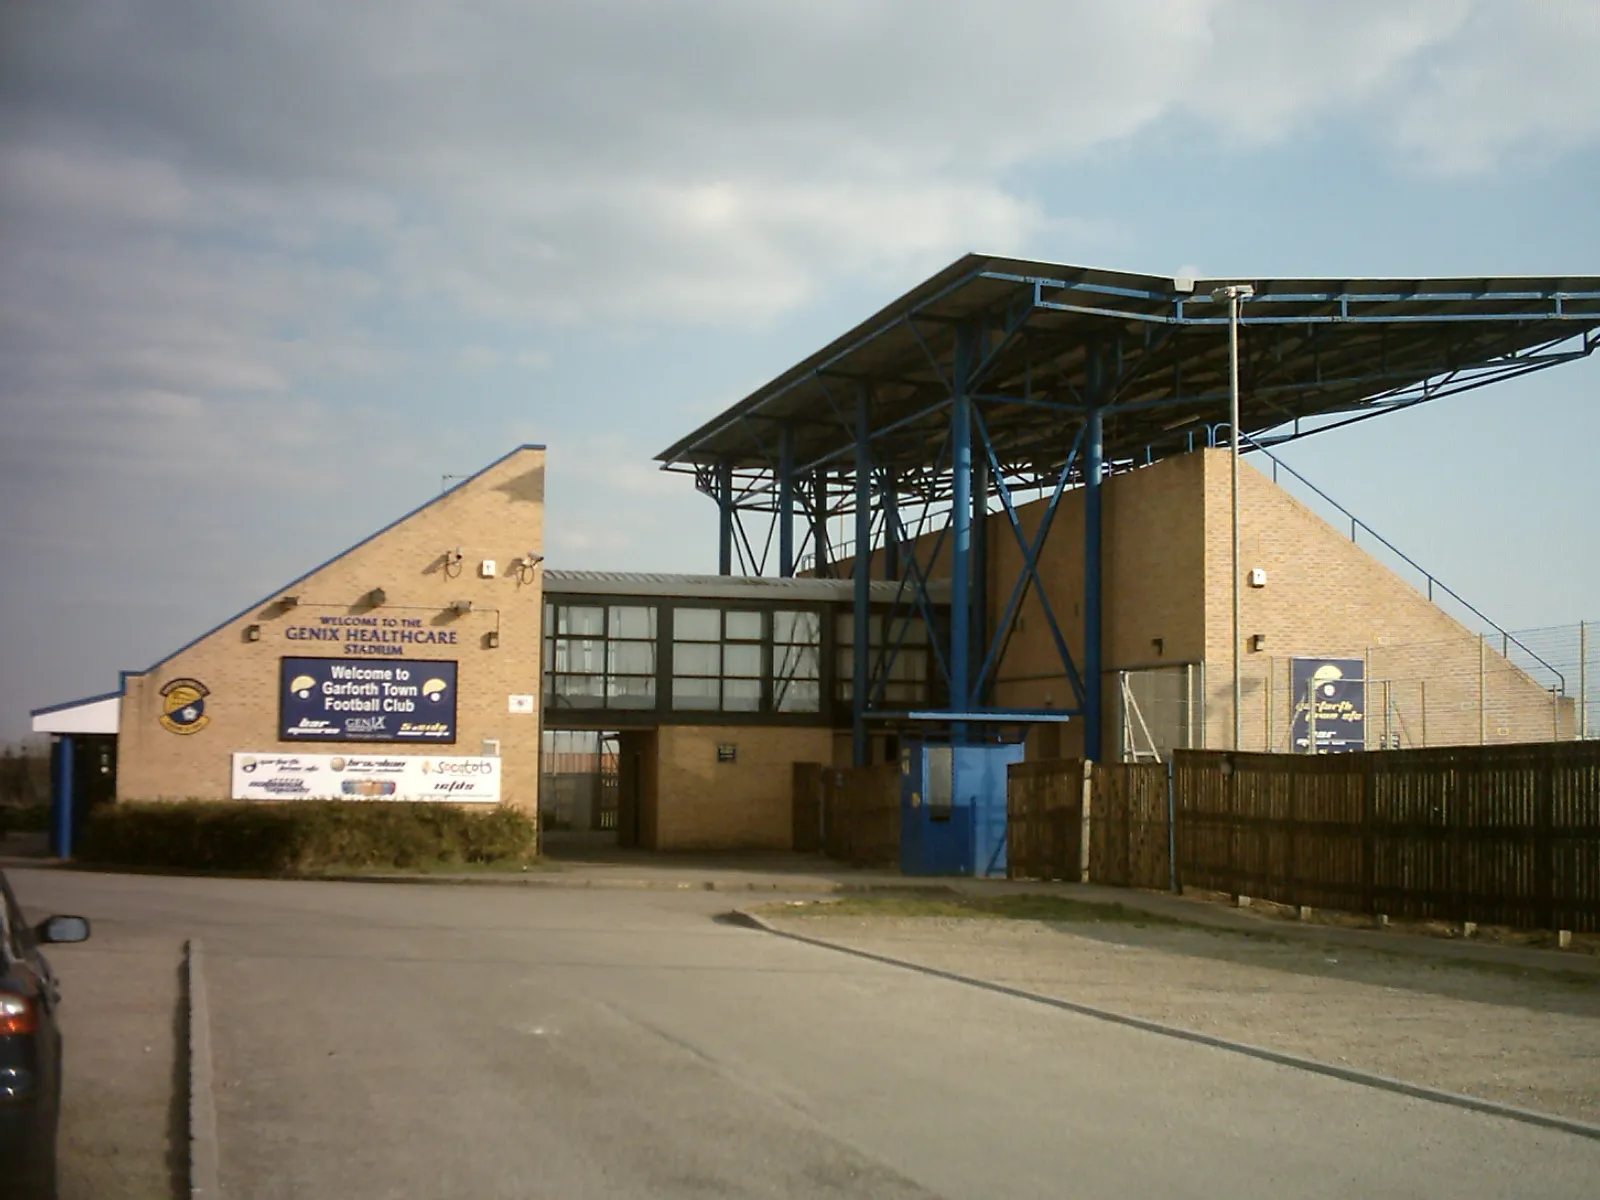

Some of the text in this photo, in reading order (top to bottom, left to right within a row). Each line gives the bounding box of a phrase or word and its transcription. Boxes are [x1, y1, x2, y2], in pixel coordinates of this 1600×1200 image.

[320, 616, 423, 628] WELCOME TO THE
[286, 627, 458, 645] GENIX HEALTHCARE
[344, 644, 404, 656] STADIUM
[330, 666, 410, 681] Welcome to
[322, 681, 418, 697] Garforth Town
[324, 697, 415, 712] Football Club
